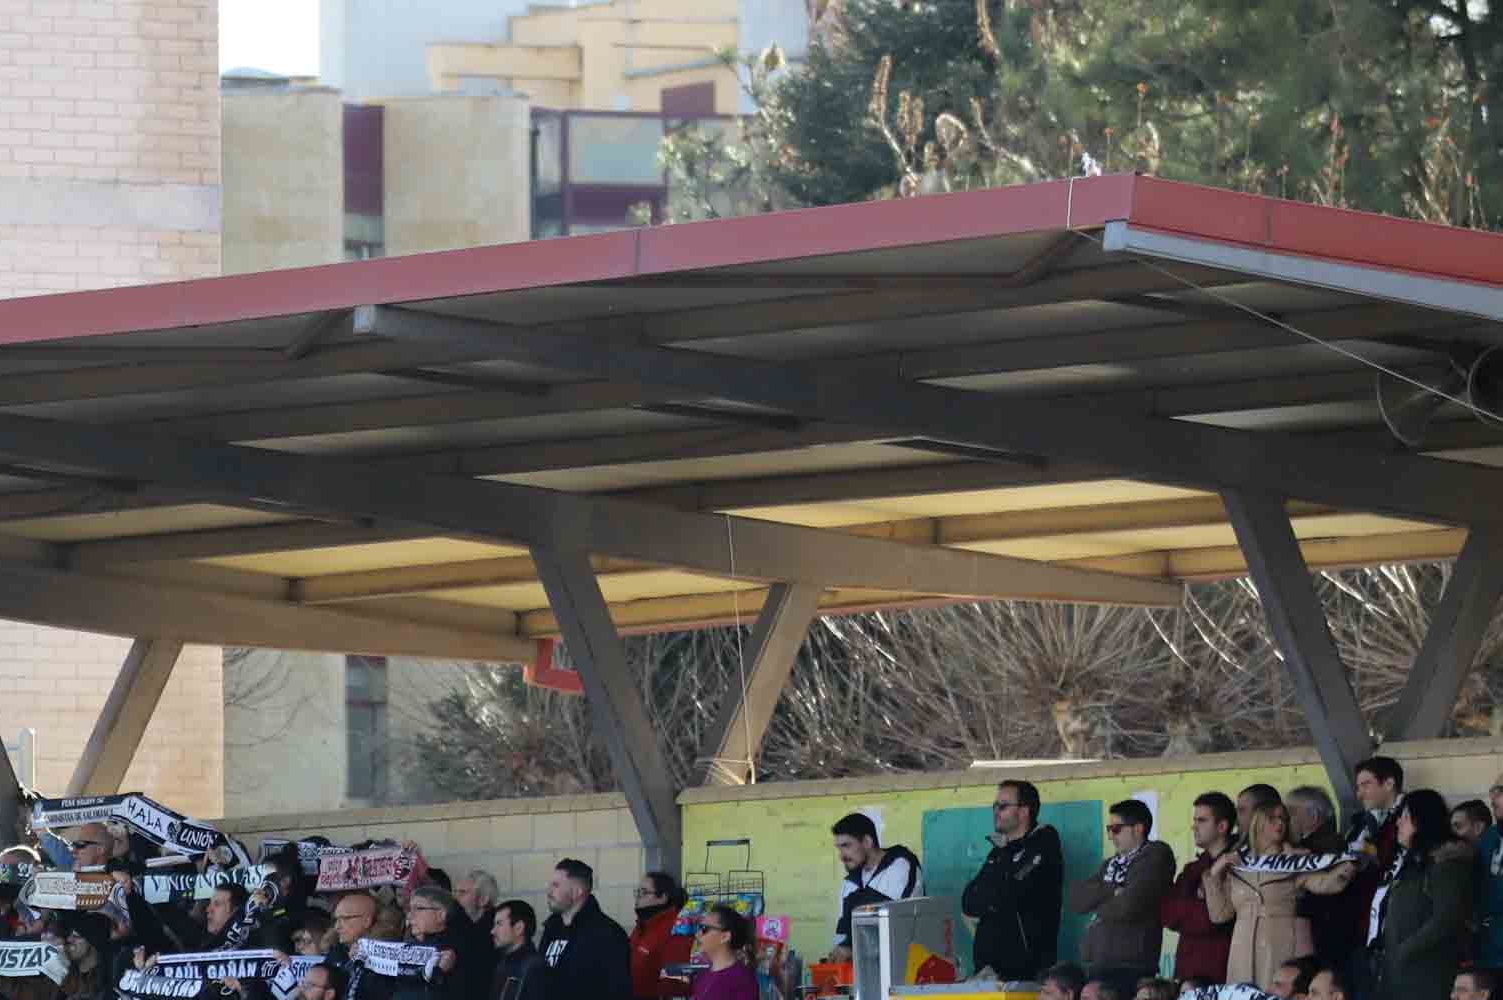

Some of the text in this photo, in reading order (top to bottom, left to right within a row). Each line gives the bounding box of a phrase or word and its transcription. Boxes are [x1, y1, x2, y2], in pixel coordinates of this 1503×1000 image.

[128, 801, 163, 833] HALA
[164, 960, 258, 979] RAÚL GAÑÁN
